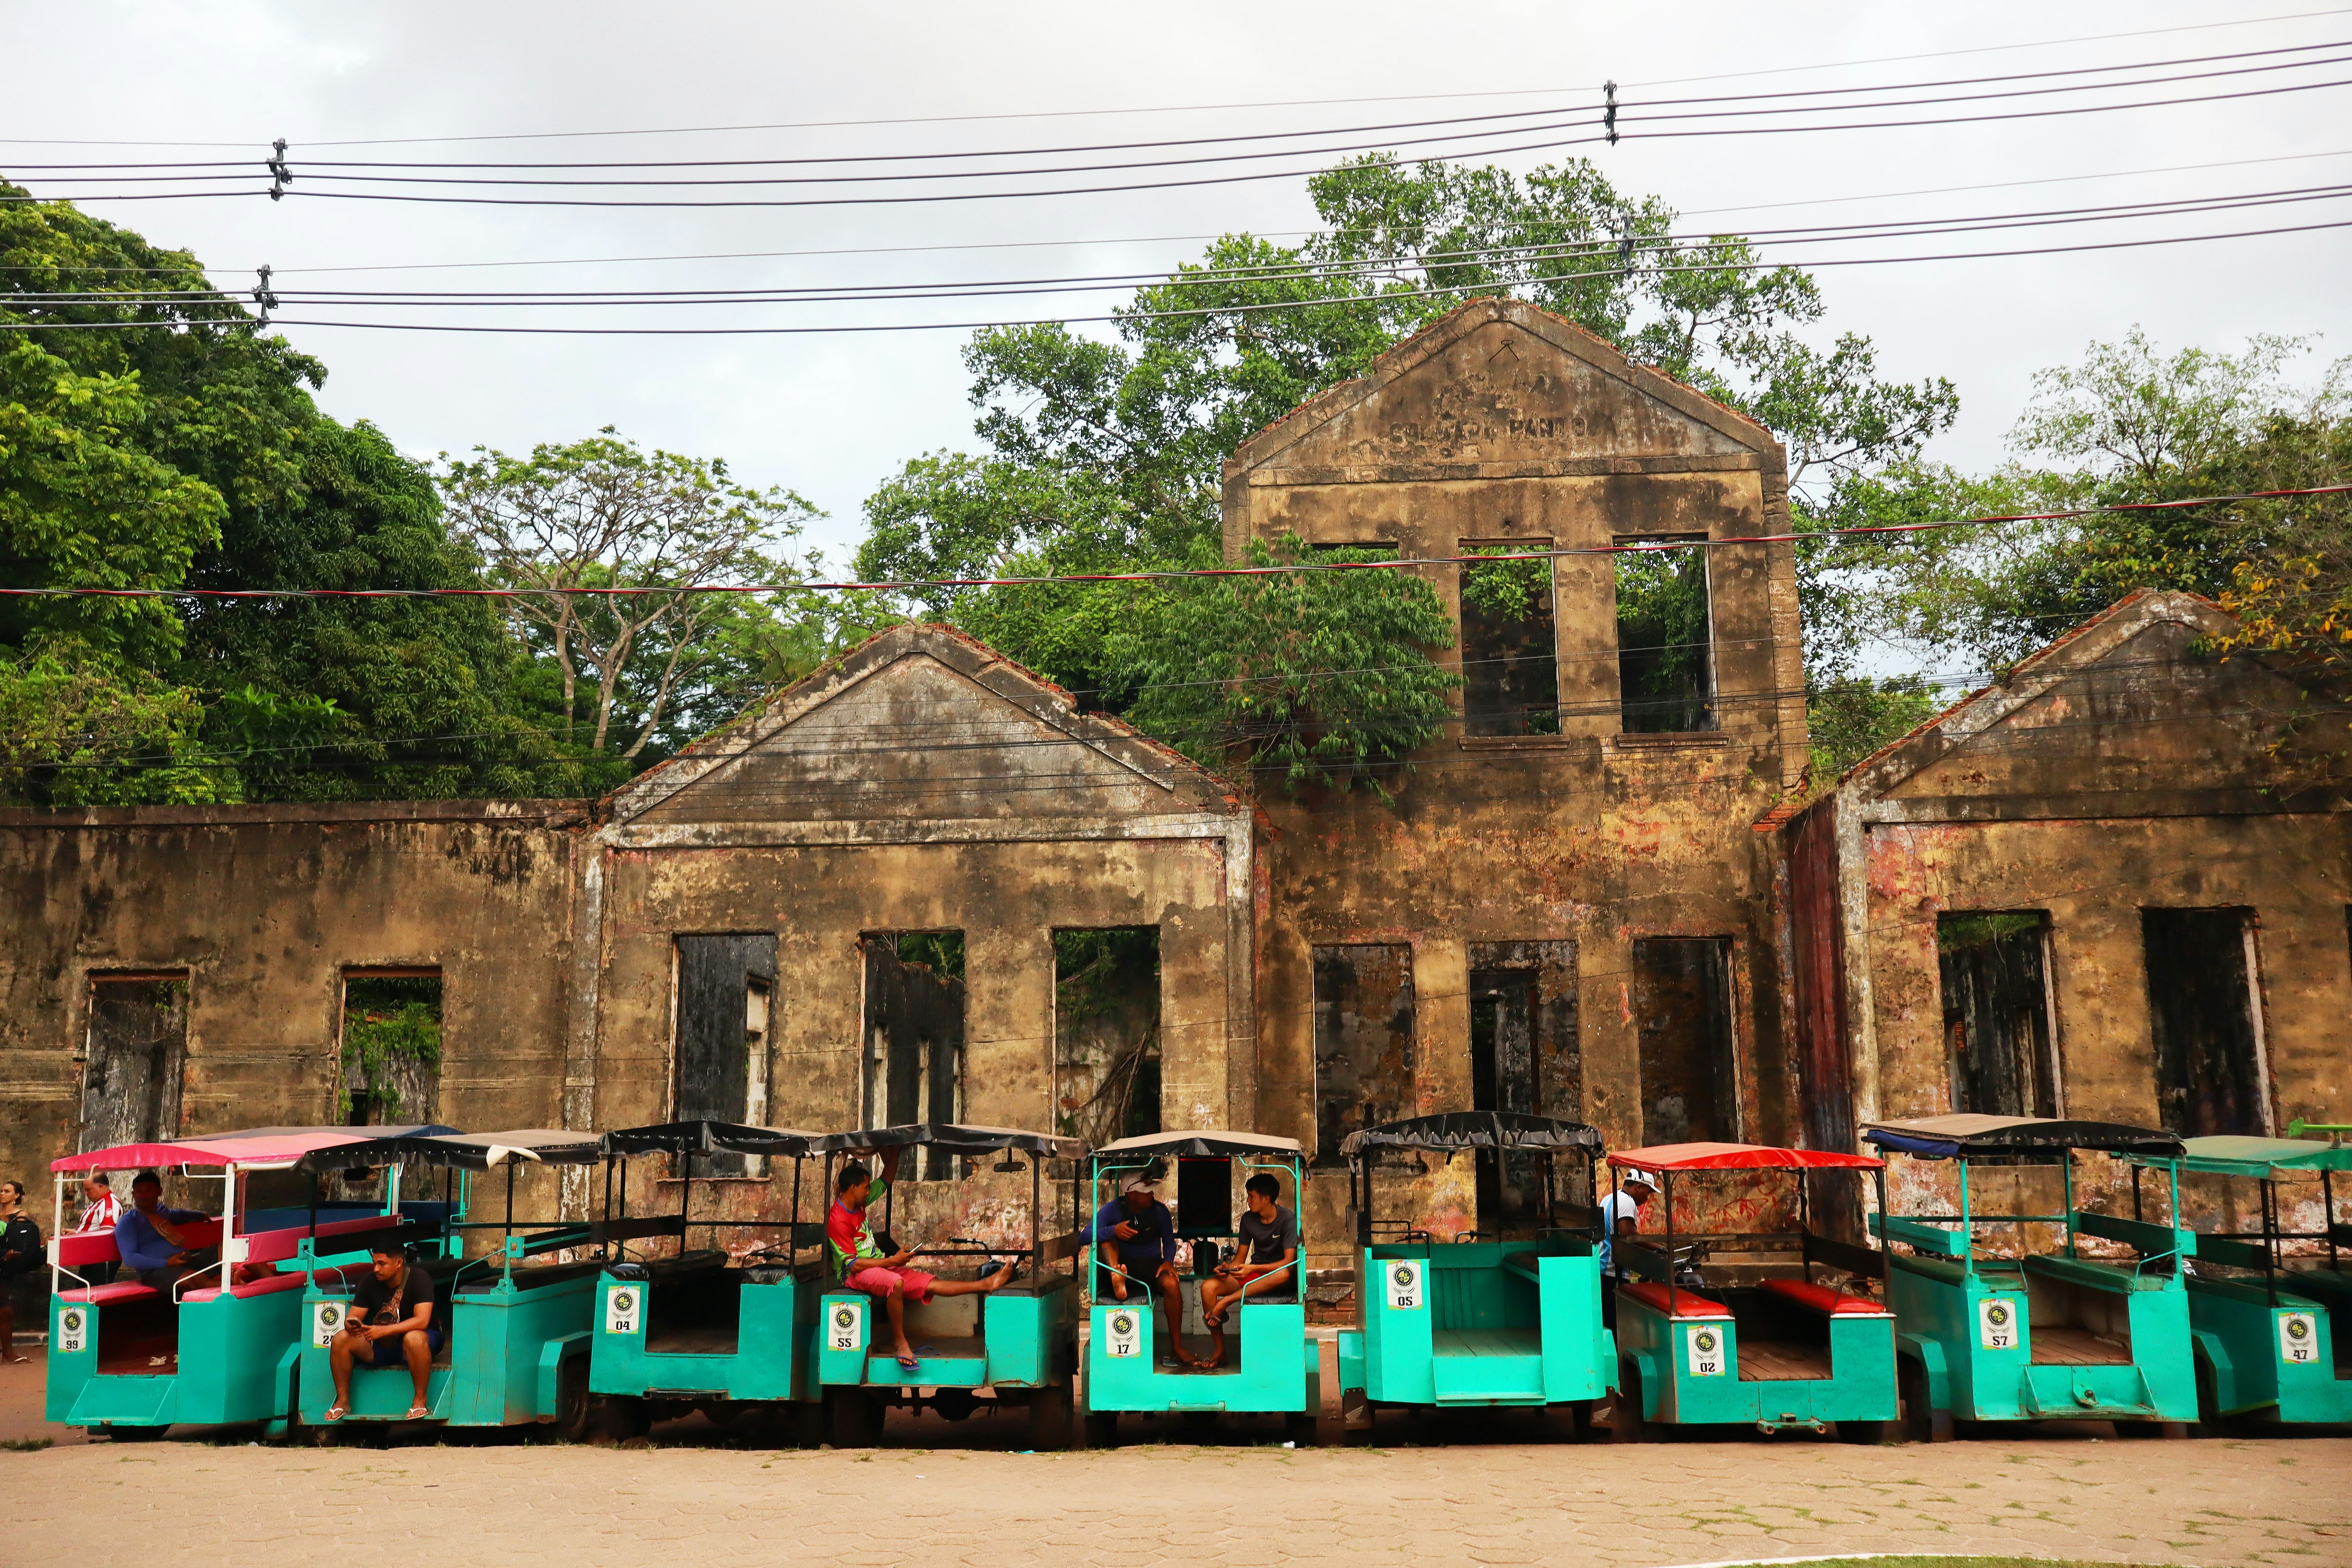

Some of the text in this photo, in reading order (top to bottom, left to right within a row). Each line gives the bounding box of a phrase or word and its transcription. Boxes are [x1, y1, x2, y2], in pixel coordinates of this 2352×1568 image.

[1398, 1296, 1412, 1306] 05
[616, 1321, 630, 1330] 04
[66, 1340, 78, 1349] 99
[838, 1338, 851, 1347] 55
[1993, 1336, 2007, 1346] 57
[1117, 1344, 1130, 1354] 17
[2293, 1350, 2308, 1360] 47
[1700, 1362, 1715, 1372] 02
